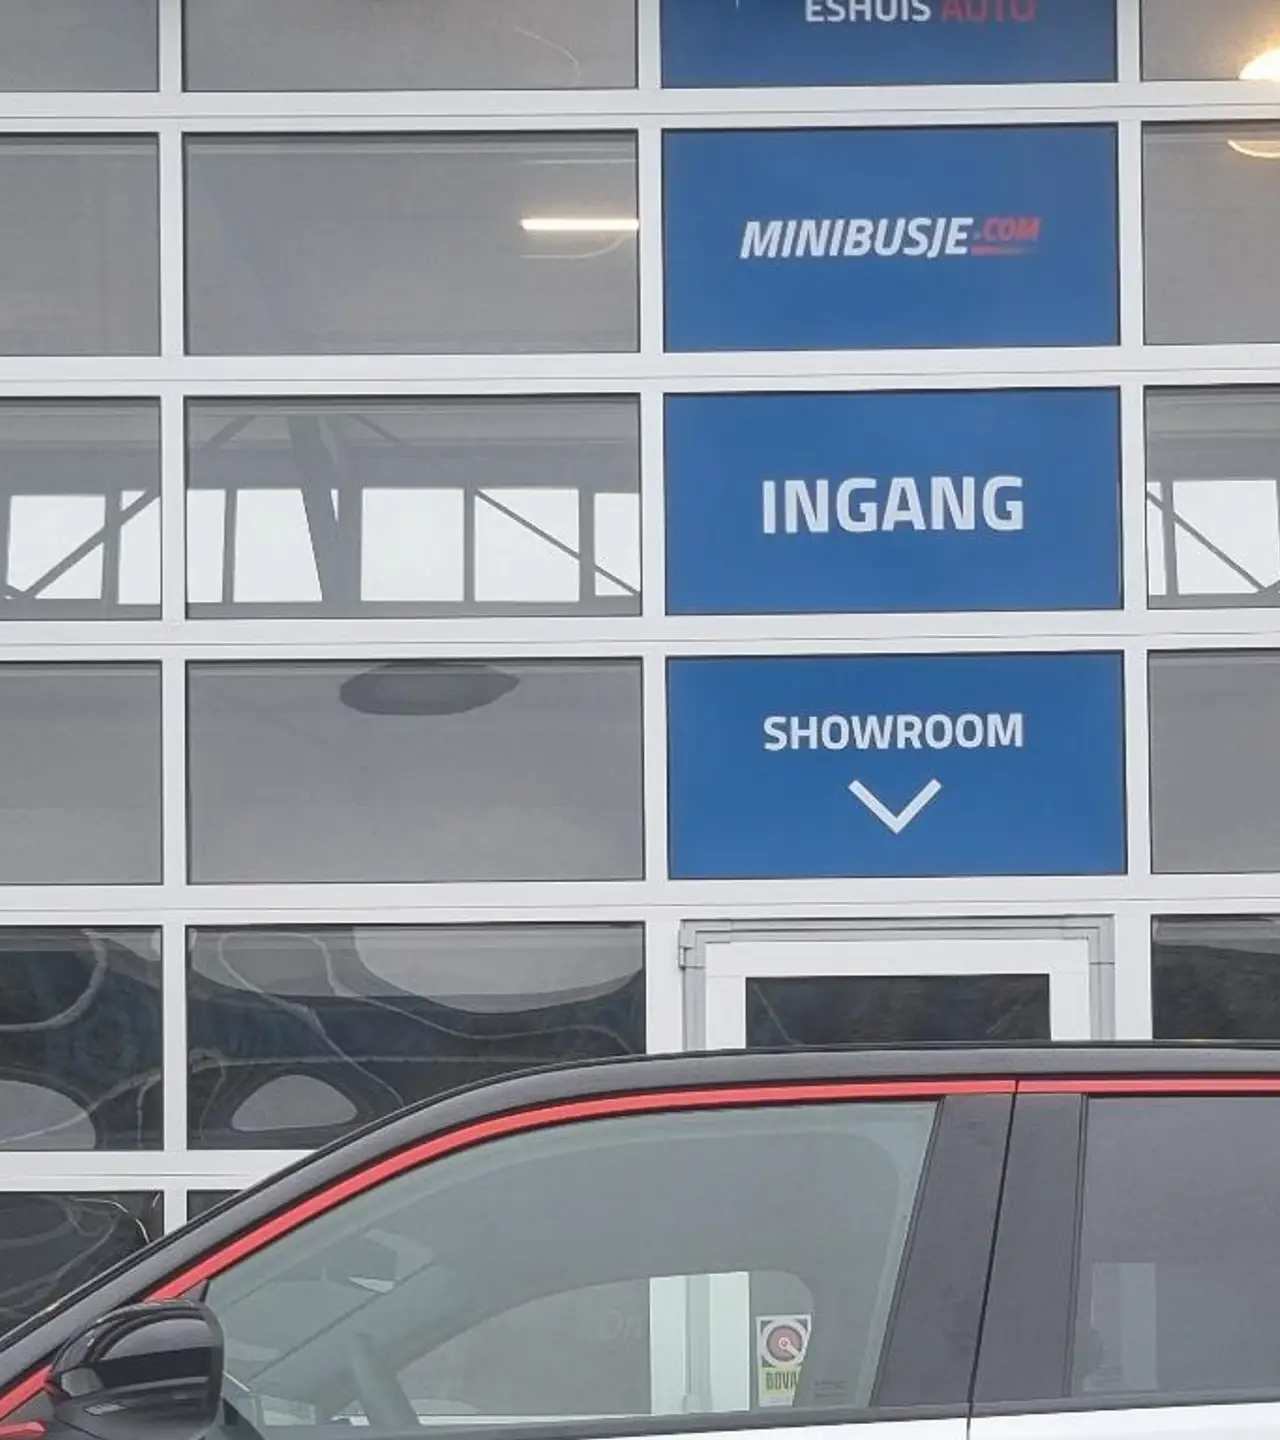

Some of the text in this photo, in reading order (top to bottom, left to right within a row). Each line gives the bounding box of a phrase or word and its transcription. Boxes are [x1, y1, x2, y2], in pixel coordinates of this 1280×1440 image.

[805, 0, 932, 22] ESHUIS
[762, 475, 1025, 535] INGANG
[763, 712, 1025, 752] SHOWROOM
